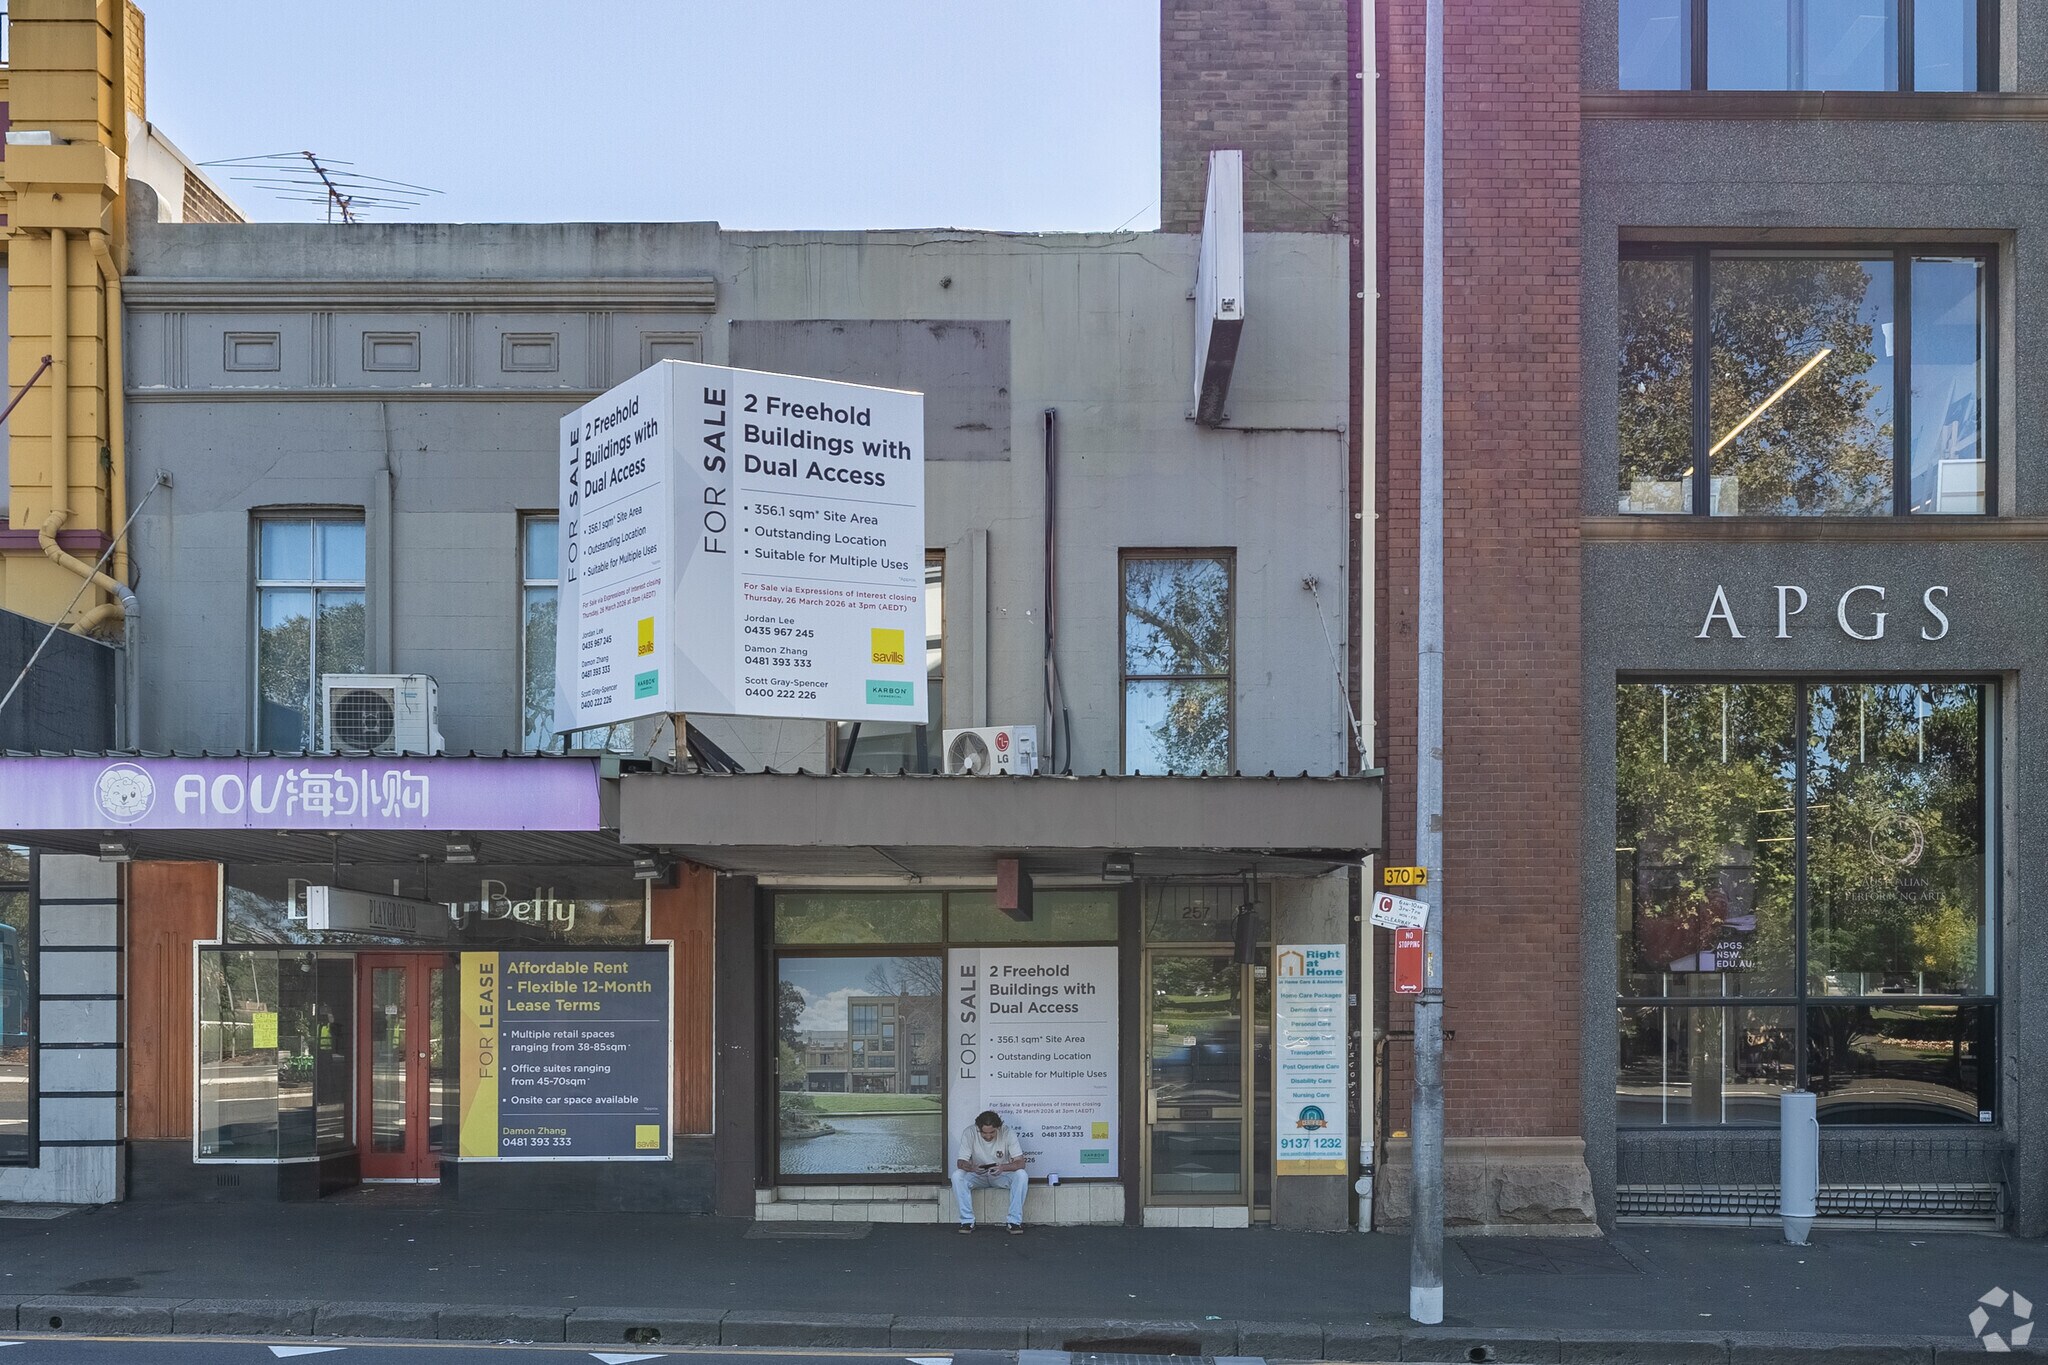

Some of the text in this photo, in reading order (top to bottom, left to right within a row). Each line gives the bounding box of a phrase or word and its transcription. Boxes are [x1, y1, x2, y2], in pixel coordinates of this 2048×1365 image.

[744, 394, 871, 426] 2 Freehold
[585, 395, 638, 441] 2 Freehold
[586, 418, 658, 469] Buildings with
[744, 424, 911, 460] Buildings with
[704, 387, 726, 554] FOR SALE
[744, 454, 886, 486] Dual Access
[585, 458, 646, 498] Dual Access
[568, 428, 579, 582] FOR SALE
[754, 504, 785, 516] 356.1
[824, 511, 846, 522] Site
[850, 513, 878, 525] Area
[588, 526, 646, 556] Outstanding Location
[755, 526, 886, 547] Outstanding Location
[755, 548, 909, 570] Suitable for Multiple Uses
[796, 587, 843, 597] Expressions
[856, 591, 886, 599] Interest
[889, 593, 917, 603] closing
[744, 594, 784, 604] Thursday,
[859, 602, 876, 610] 3pm
[879, 603, 907, 612] (AEDT)
[1695, 584, 1949, 641] APGS
[744, 615, 795, 624] Jordan Lee
[744, 626, 814, 638] 0435 967 245
[745, 645, 808, 657] Damon Zhang
[745, 656, 812, 668] 0481 393 333
[873, 652, 903, 663] savills
[745, 677, 828, 688] Scott Gray-Spencer
[745, 689, 816, 700] 0400 222 226
[998, 754, 1008, 763] LG
[1386, 870, 1410, 883] 370
[480, 880, 575, 931] Betty
[1382, 898, 1390, 911] C
[370, 899, 416, 929] PLAYGROUND
[1183, 907, 1210, 919] 257
[1307, 950, 1340, 959] Right
[507, 962, 628, 974] Affordable Rent
[990, 965, 1069, 977] 2 Freehold
[518, 981, 652, 993] Flexible 12-Month
[990, 983, 1096, 997] Buildings with
[507, 1000, 600, 1011] Lease Terms
[990, 1002, 1078, 1014] Dual Access
[480, 963, 494, 1078] FOR LEASE
[961, 965, 976, 1079] FOR SALE
[511, 1030, 550, 1040] Multiple
[554, 1030, 578, 1038] retail
[511, 1044, 548, 1053] ranging
[552, 1043, 574, 1051] from
[997, 1052, 1091, 1062] Outstanding Location
[511, 1064, 611, 1075] Office suites ranging
[1050, 1070, 1084, 1079] Multiple
[511, 1077, 534, 1086] from
[511, 1096, 542, 1104] Onsite
[595, 1096, 638, 1104] available
[538, 1127, 567, 1136] Zhang
[503, 1138, 572, 1147] 0481 393 333
[1281, 1138, 1342, 1148] 9137 1232
